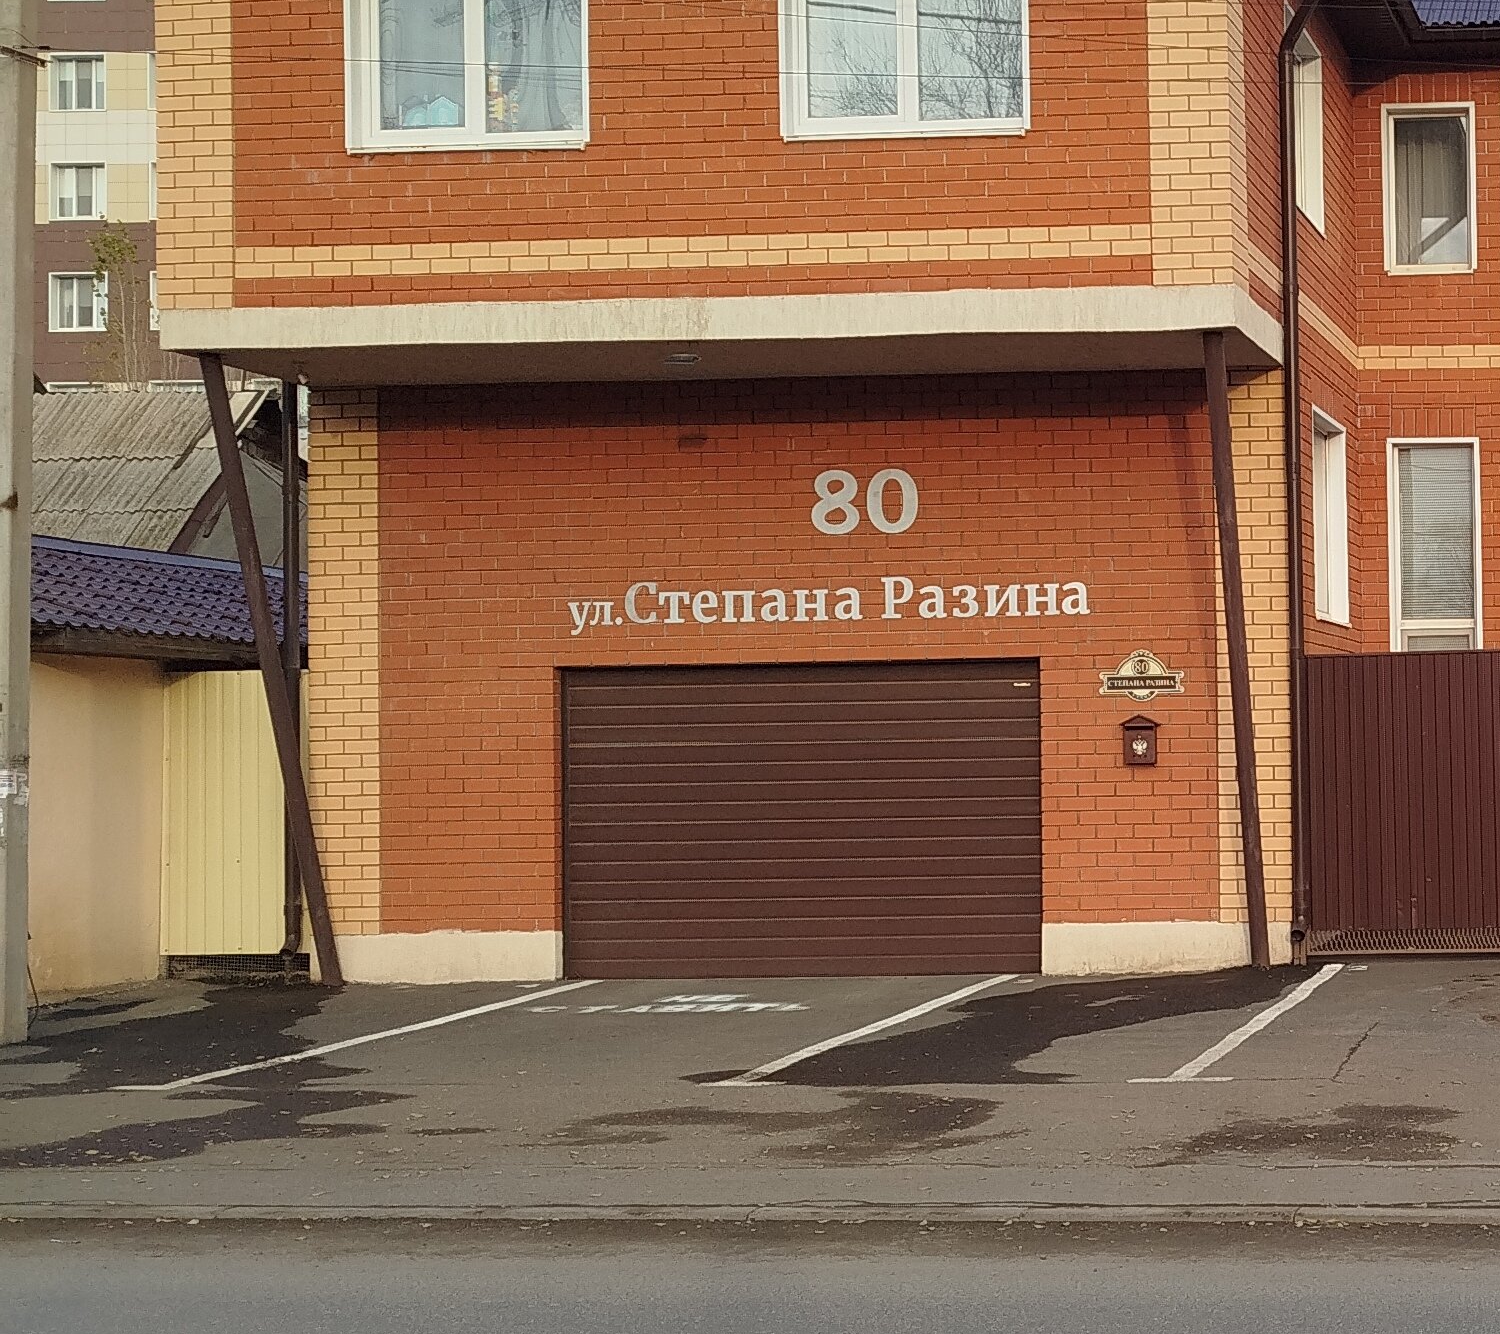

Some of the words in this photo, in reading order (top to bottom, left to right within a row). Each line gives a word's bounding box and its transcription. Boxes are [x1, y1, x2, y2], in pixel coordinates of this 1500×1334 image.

[811, 468, 920, 534] 80
[880, 577, 1091, 620] Разина
[1134, 661, 1149, 673] 80
